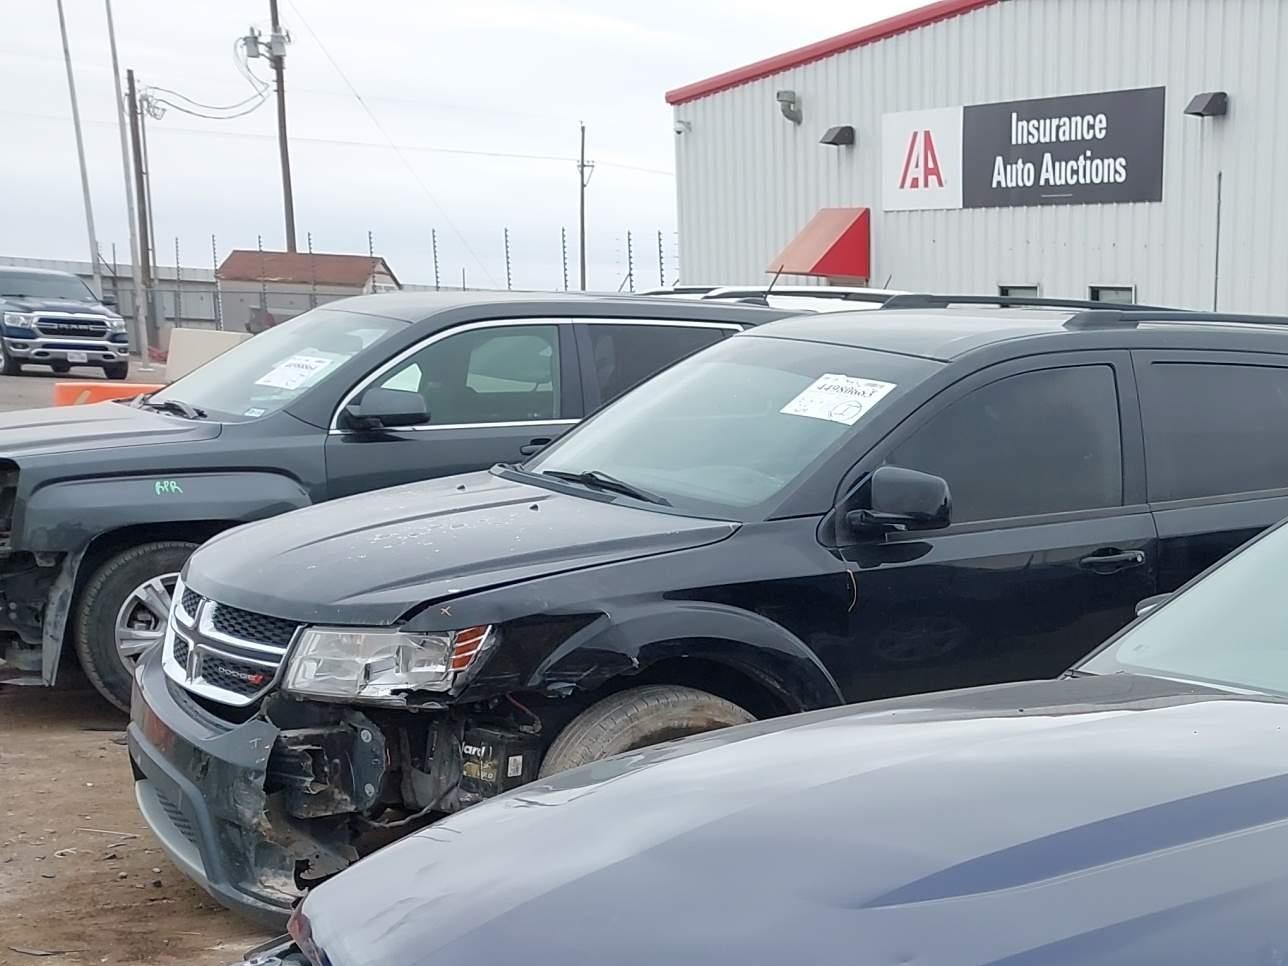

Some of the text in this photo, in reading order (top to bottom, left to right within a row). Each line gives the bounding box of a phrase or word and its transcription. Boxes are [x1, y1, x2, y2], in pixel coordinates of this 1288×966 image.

[1011, 112, 1107, 145] Insurance
[991, 149, 1127, 188] Auto Auctions
